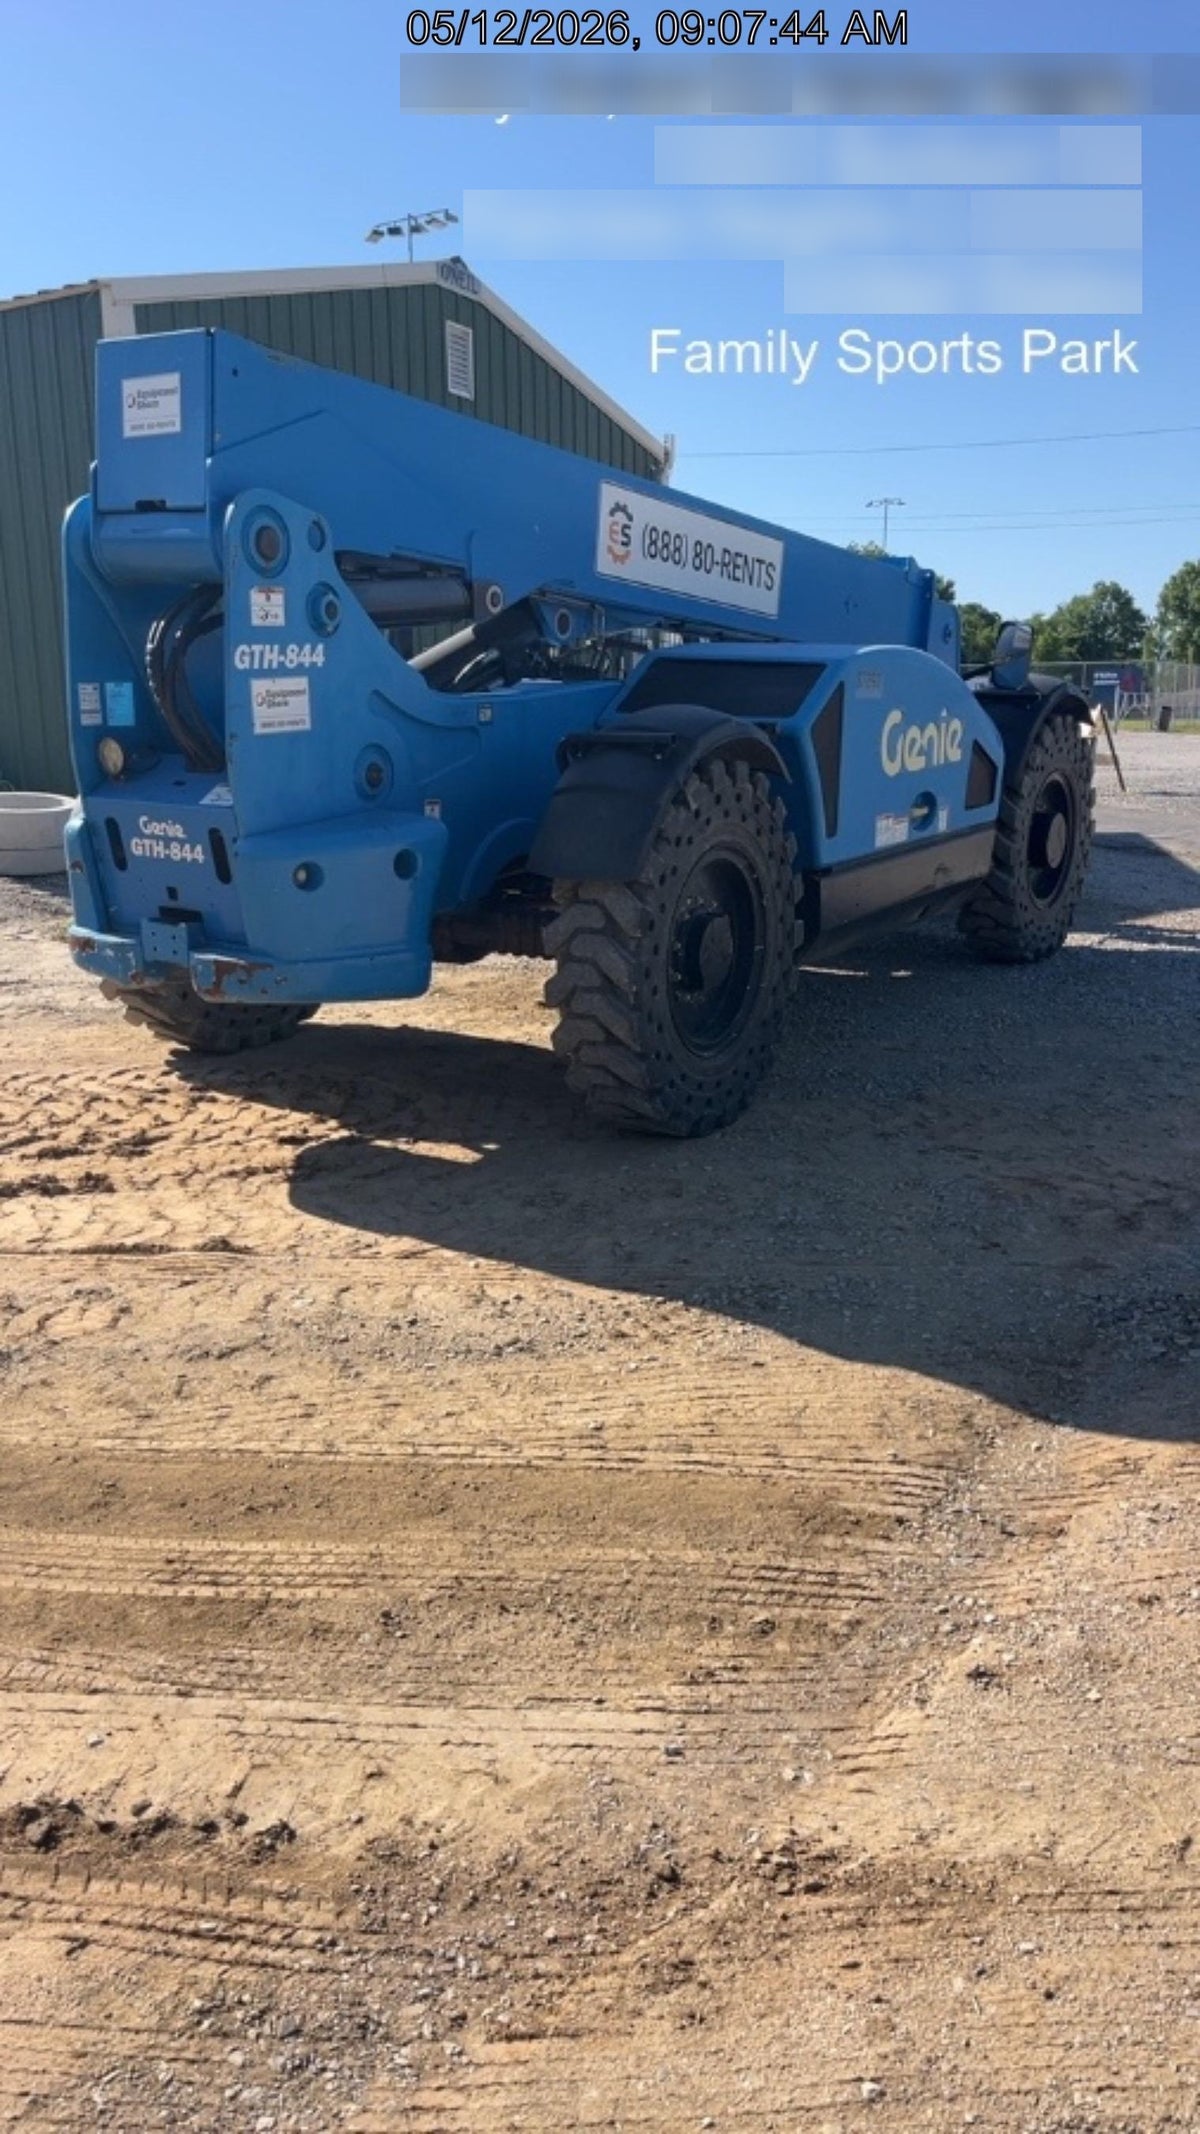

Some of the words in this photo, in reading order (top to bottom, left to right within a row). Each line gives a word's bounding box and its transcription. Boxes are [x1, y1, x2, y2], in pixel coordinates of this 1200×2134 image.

[642, 521, 689, 571] (888)
[691, 539, 777, 592] 80-RENTS
[234, 642, 326, 670] GTH-844
[880, 707, 962, 778] Genie
[139, 815, 187, 839] Genie
[131, 837, 205, 864] GTH-844
